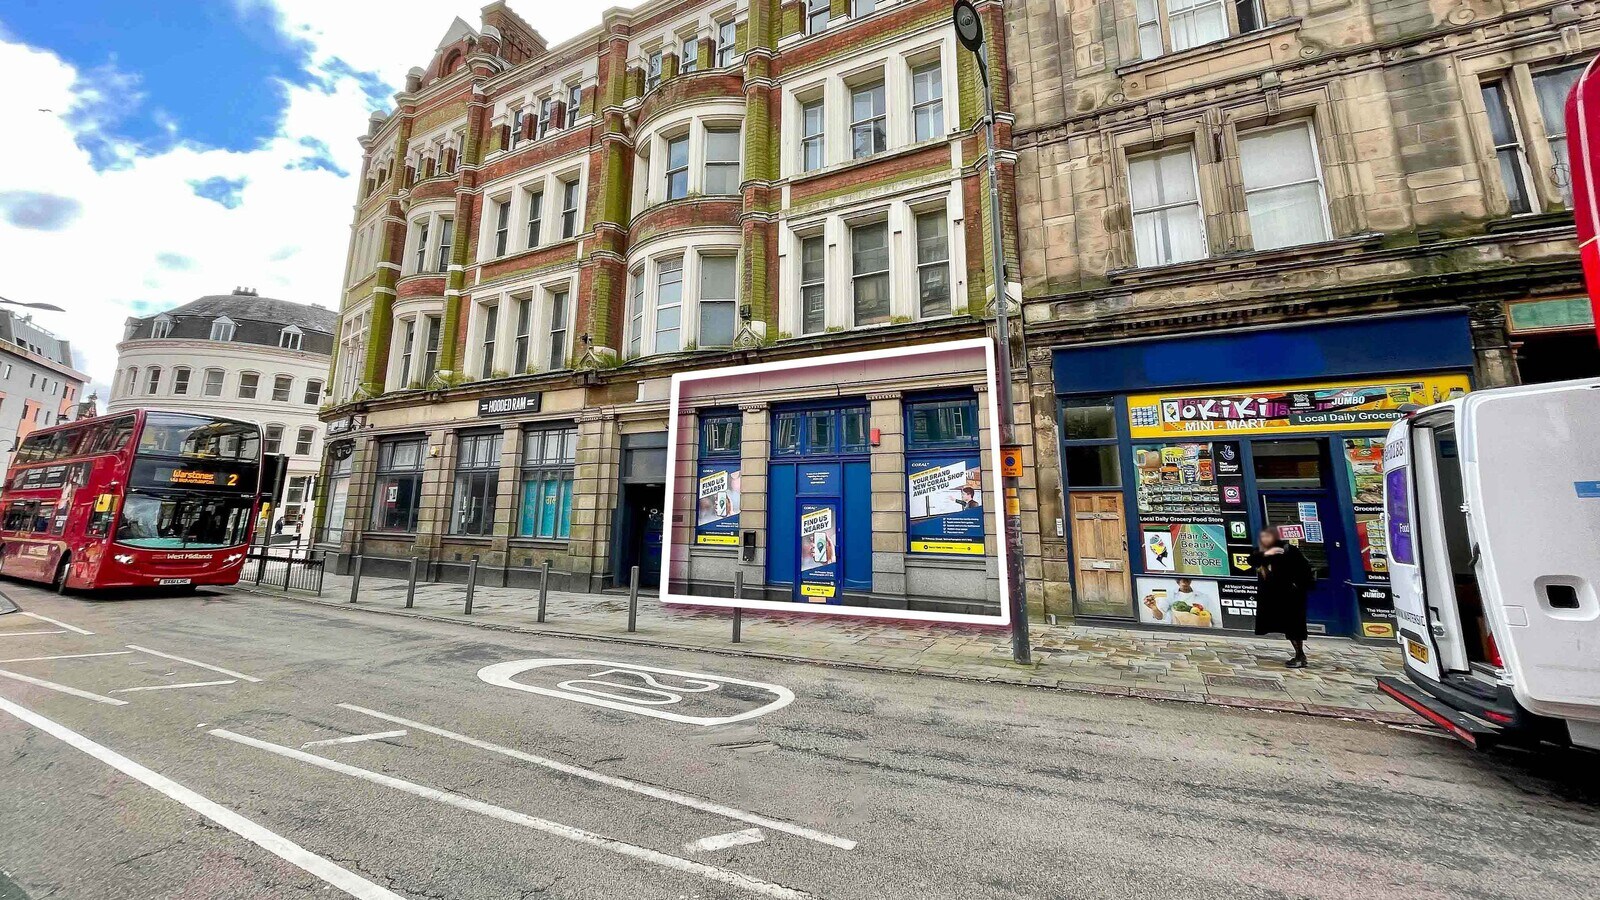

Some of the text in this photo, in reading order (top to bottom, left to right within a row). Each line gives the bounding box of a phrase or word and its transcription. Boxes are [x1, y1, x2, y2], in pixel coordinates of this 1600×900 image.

[489, 397, 526, 412] HOODED RAM
[1331, 396, 1365, 406] JUMBO
[1226, 418, 1266, 430] MART
[1298, 415, 1327, 423] Local
[1330, 413, 1356, 423] Daily
[227, 474, 238, 486] 2
[702, 477, 725, 489] FIND US
[912, 474, 929, 485] YOUR
[929, 469, 950, 480] BRAND
[912, 482, 926, 492] NEW
[926, 477, 947, 488] CORAL
[948, 471, 964, 481] SHOP
[702, 483, 725, 496] NEARBY
[913, 482, 949, 497] AWAITS YOU
[803, 514, 828, 527] FIND US
[803, 521, 829, 534] NEARBY
[1201, 532, 1209, 540] &
[1181, 541, 1215, 551] Beauty
[1183, 558, 1222, 566] INSTORE
